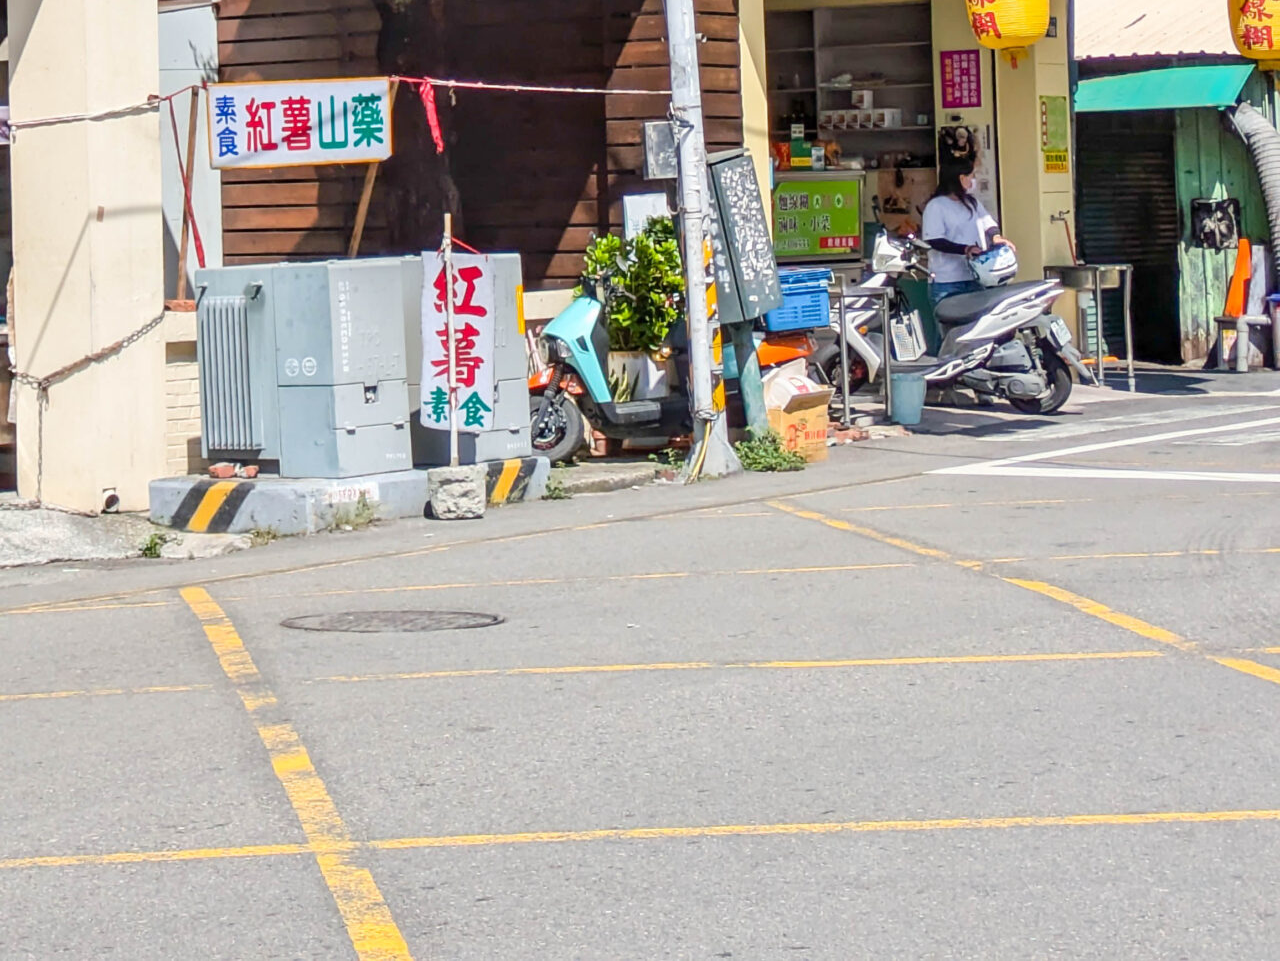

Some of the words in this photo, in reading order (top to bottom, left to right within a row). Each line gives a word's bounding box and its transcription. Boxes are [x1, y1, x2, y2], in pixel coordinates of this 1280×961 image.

[215, 94, 239, 157] 素食
[245, 93, 384, 153] 紅薯山藥
[431, 263, 488, 387] 紅薯
[423, 385, 493, 428] 素食
